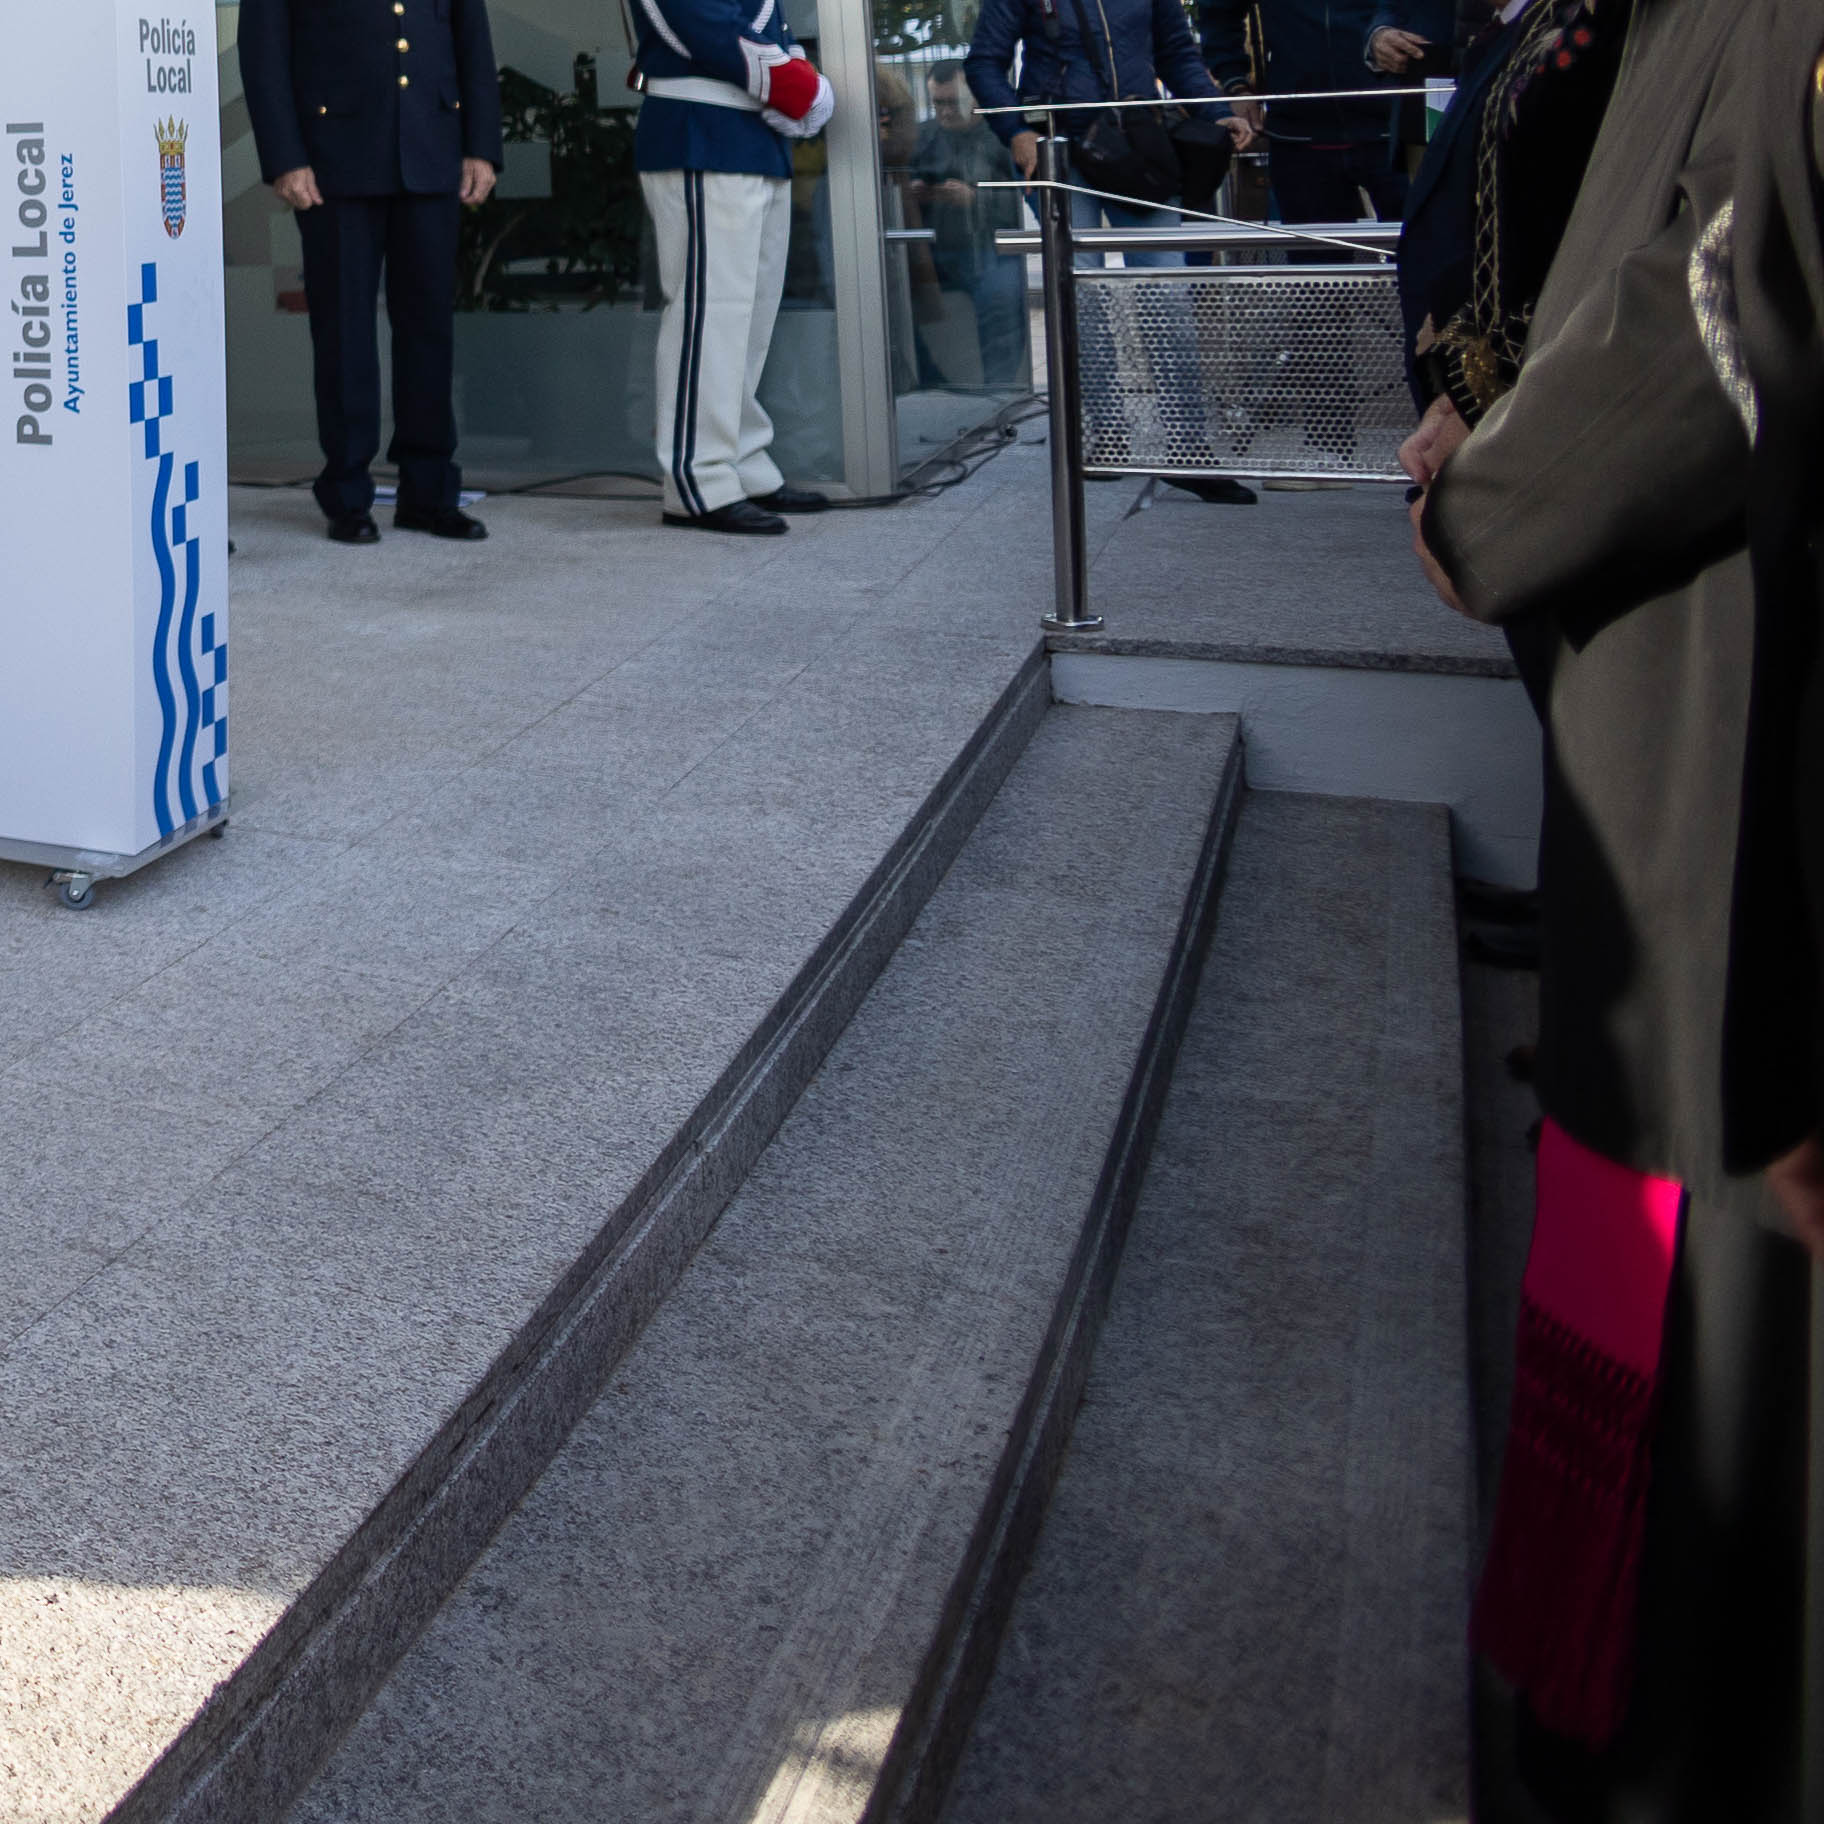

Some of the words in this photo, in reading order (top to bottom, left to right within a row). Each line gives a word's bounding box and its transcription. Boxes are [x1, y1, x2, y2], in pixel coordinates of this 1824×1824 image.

[138, 18, 196, 56] Policía
[146, 57, 192, 94] Local
[6, 122, 49, 257] Local
[57, 152, 79, 211] Jerez
[59, 217, 76, 244] de
[11, 274, 53, 445] Policía
[61, 251, 85, 414] Ayuntamiento
